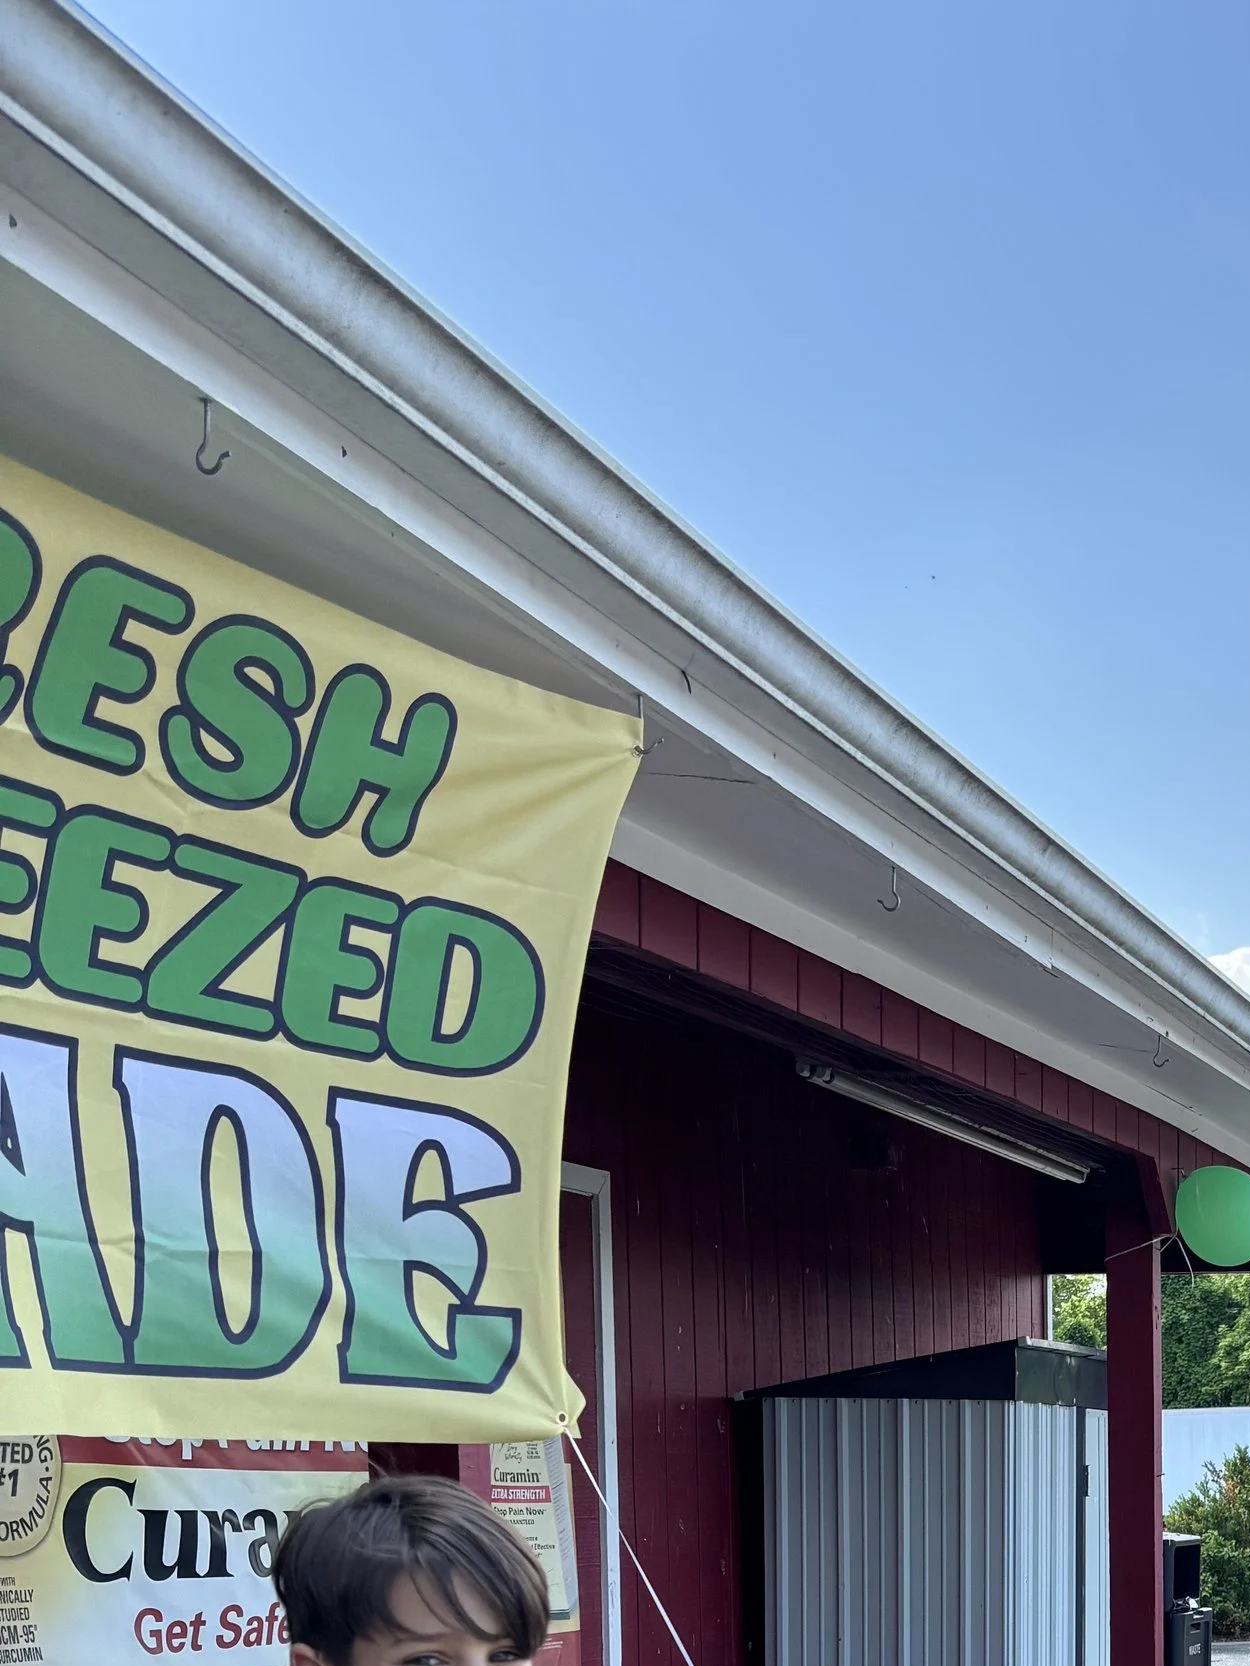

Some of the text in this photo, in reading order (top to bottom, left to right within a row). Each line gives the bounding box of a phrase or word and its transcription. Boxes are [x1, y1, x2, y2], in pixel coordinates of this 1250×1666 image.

[0, 1020, 523, 1394] ADE
[493, 1467, 541, 1483] Curamin
[508, 1488, 546, 1500] STRENGTH
[62, 1477, 302, 1583] Cura
[0, 1607, 31, 1622] TUDIED
[0, 1624, 37, 1646] CM-95
[133, 1602, 292, 1655] Get Safe
[0, 1647, 44, 1665] URCUMIN
